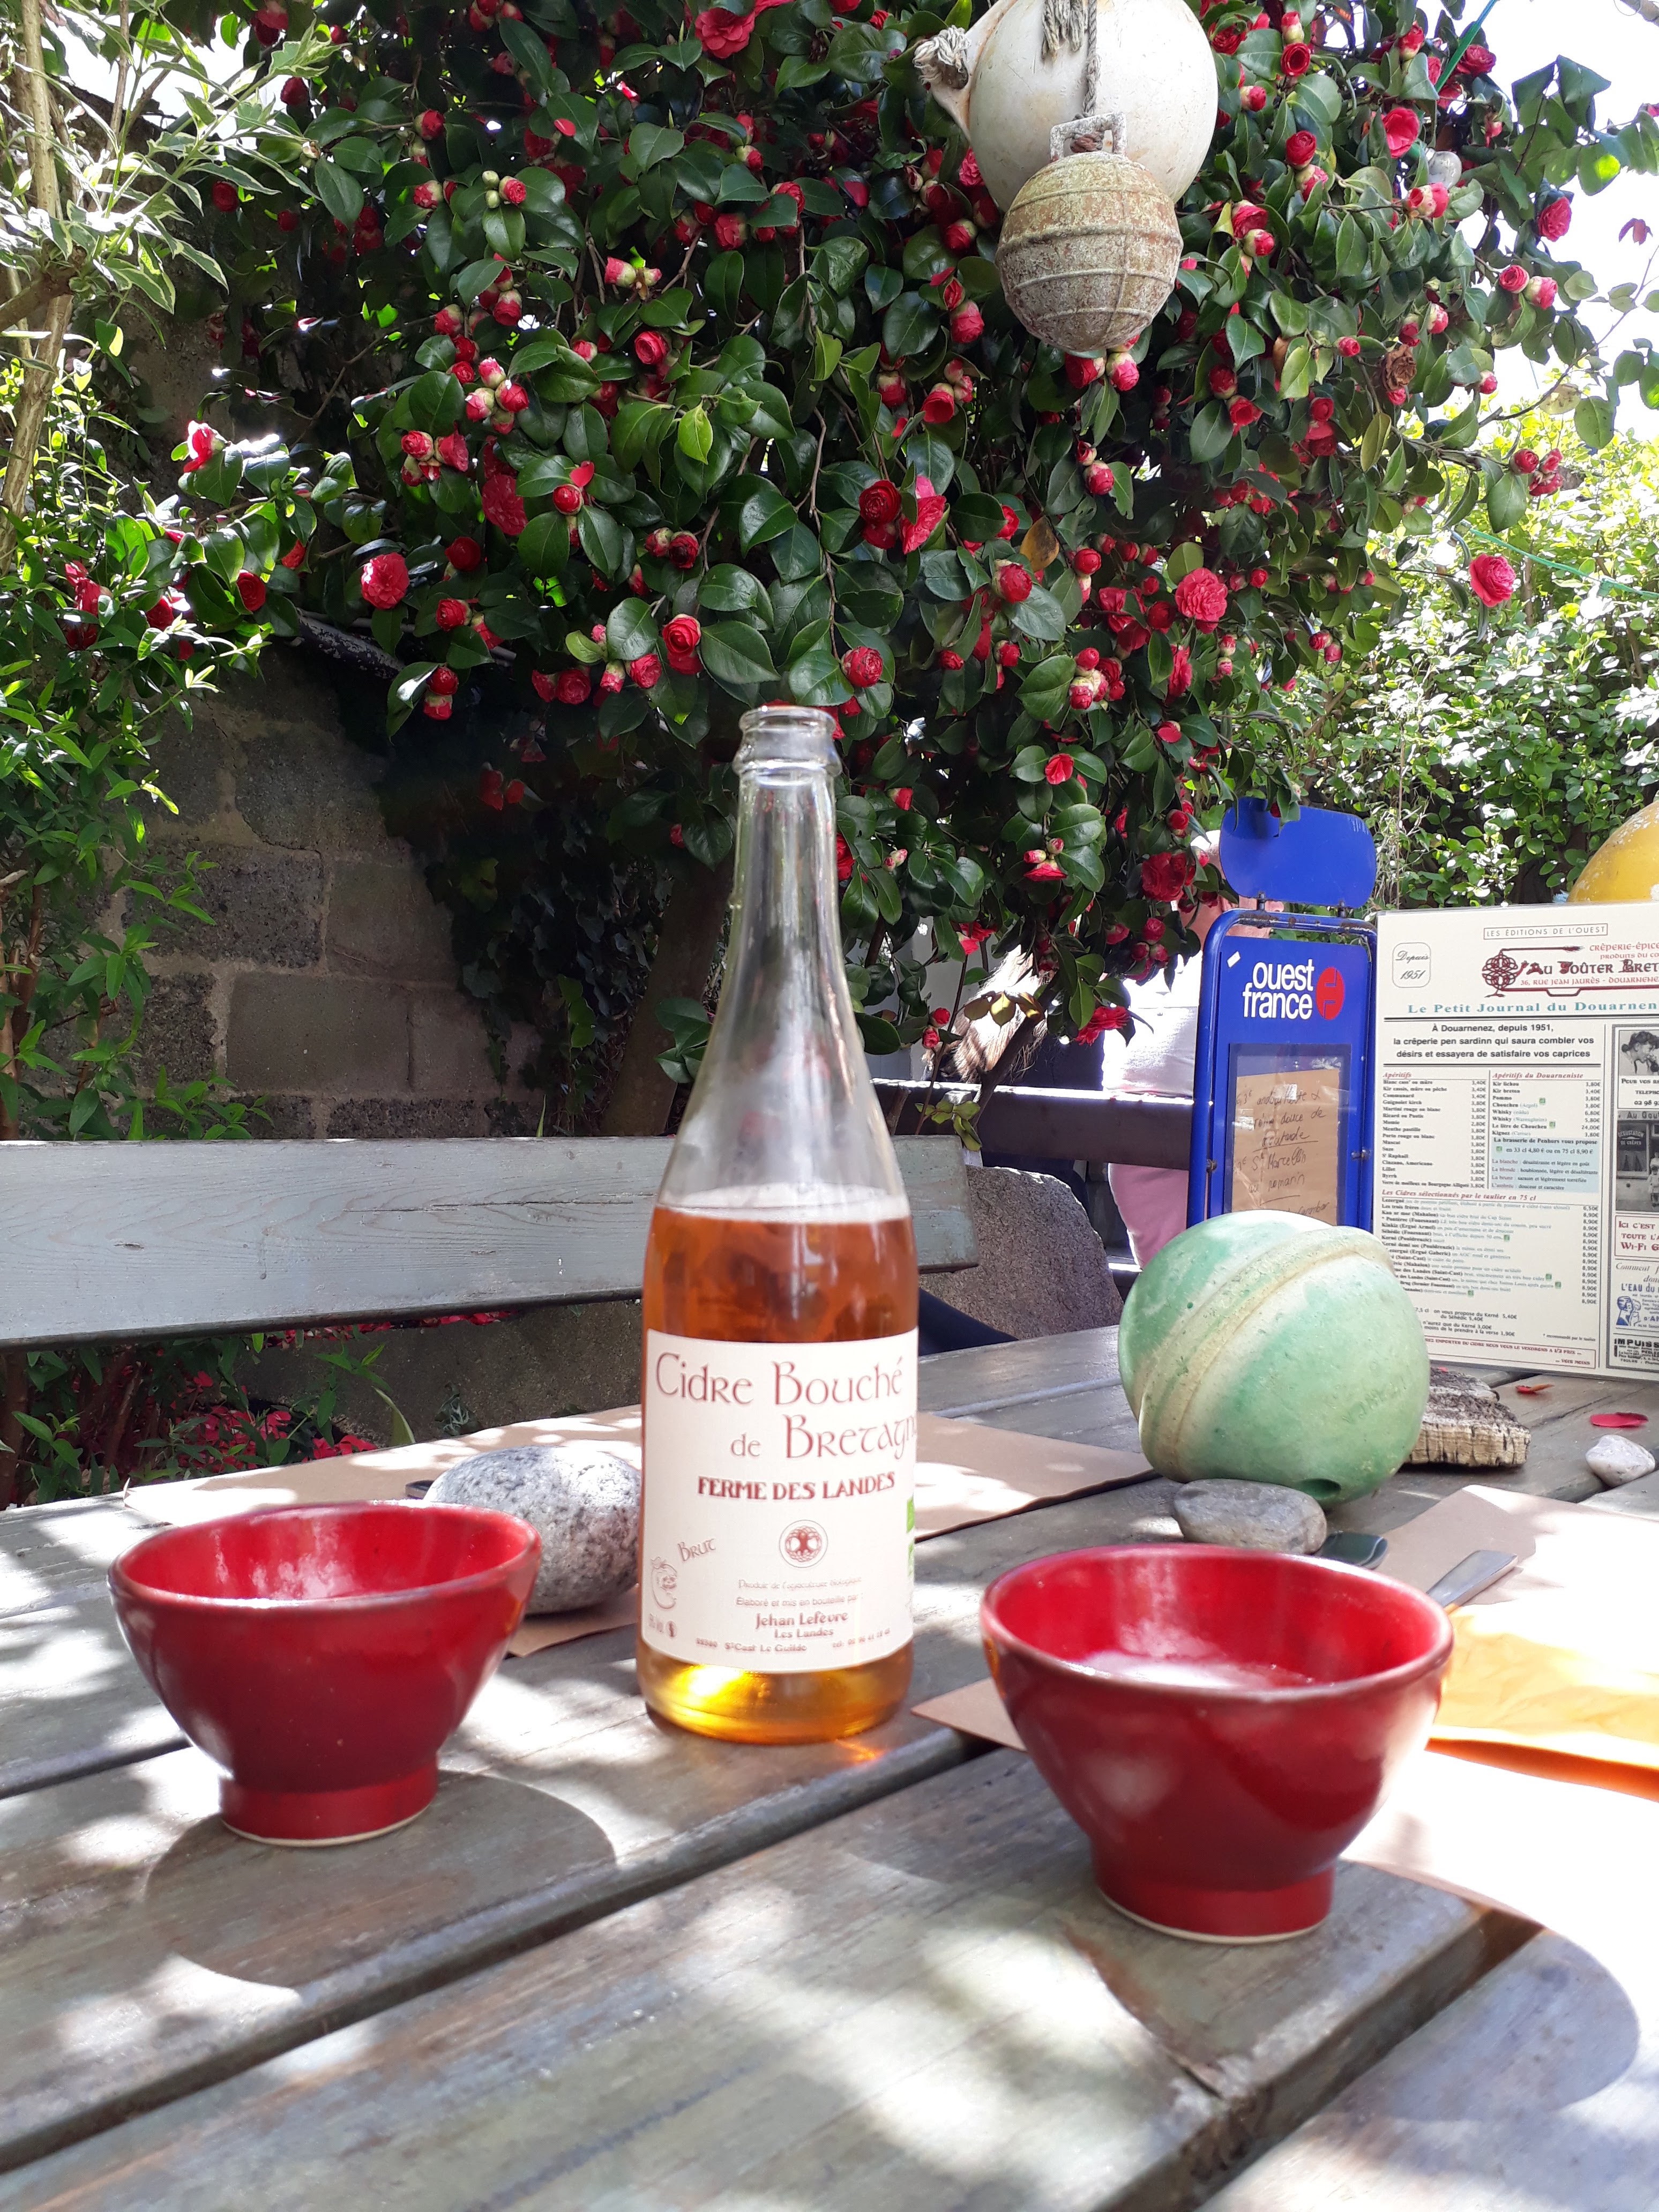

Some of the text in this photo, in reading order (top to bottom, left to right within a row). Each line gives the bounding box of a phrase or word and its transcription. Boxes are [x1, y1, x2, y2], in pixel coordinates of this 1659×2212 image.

[1395, 951, 1430, 963] Depuis
[1252, 959, 1314, 991] ouest
[1400, 970, 1426, 979] 1951
[1572, 977, 1600, 985] JAURÈS
[1242, 982, 1312, 1019] france
[1408, 1002, 1657, 1013] Le Petit Journal du Douarnen
[1432, 1023, 1438, 1032] À
[1498, 1025, 1528, 1033] depuis
[1531, 1024, 1553, 1032] 1951,
[1552, 1050, 1590, 1058] caprices
[1311, 1107, 1326, 1119] de
[1621, 1283, 1654, 1292] L'EAU du
[655, 1352, 903, 1406] Cidre Bouché
[730, 1433, 761, 1458] de
[698, 1471, 895, 1500] FERME DES LANDES
[736, 1597, 768, 1606] Elaboré
[756, 1611, 848, 1629] Jehan Lefèvre
[774, 1628, 834, 1638] Les Landes
